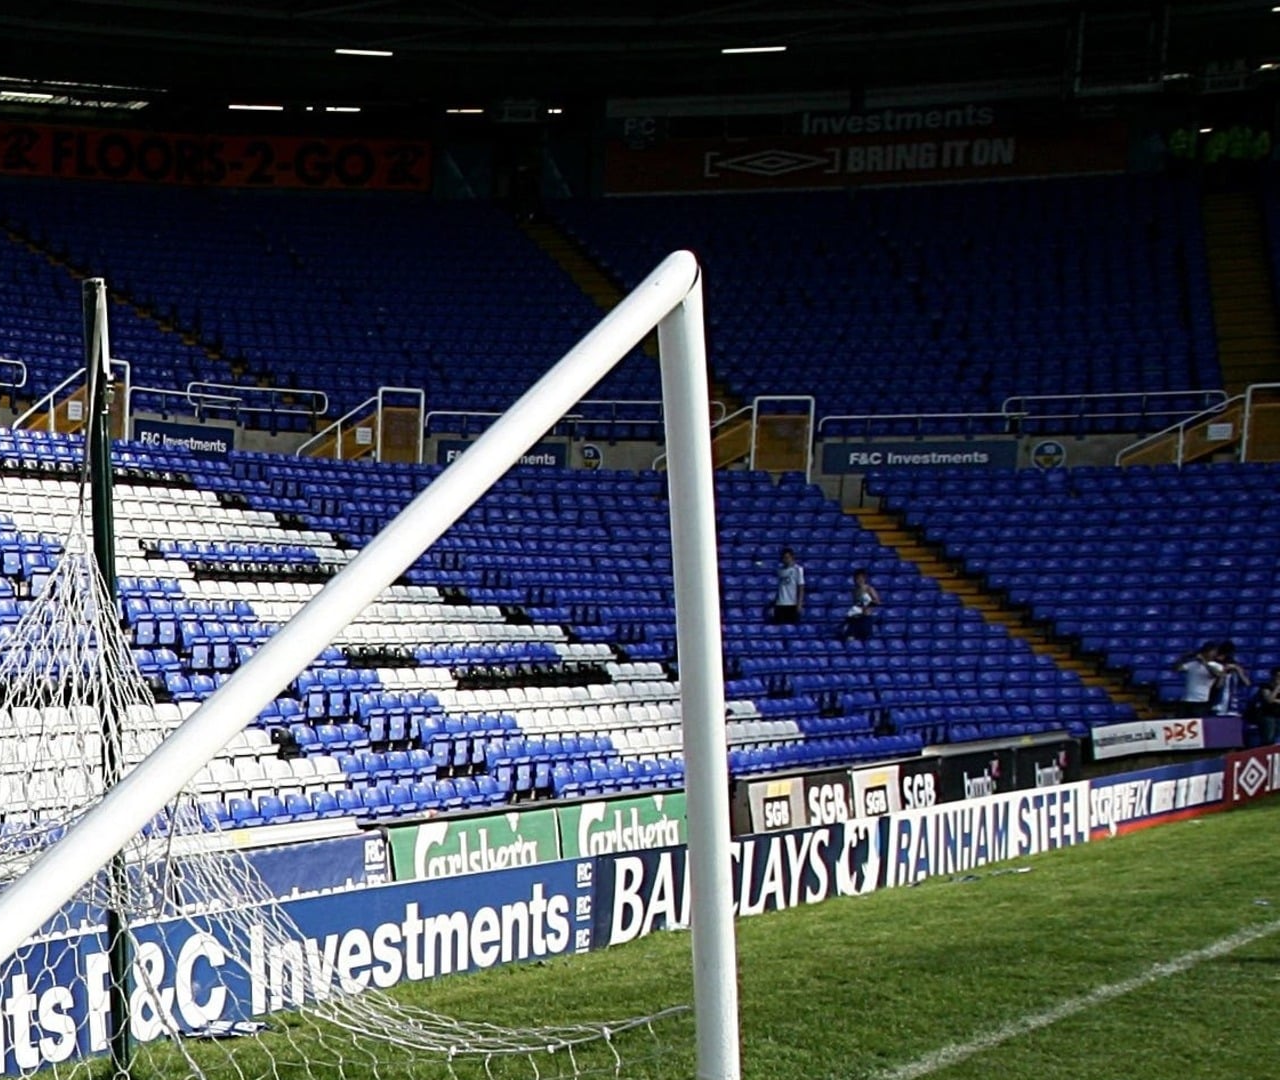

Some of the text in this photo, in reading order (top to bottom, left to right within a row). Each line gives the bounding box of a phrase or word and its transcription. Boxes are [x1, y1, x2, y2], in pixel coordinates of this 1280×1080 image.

[51, 130, 377, 187] FLOORS-2-GO
[846, 144, 938, 174] BRING
[971, 137, 1016, 167] ON
[140, 430, 160, 447] F&C
[849, 450, 990, 466] F&C Investments
[764, 783, 849, 828] SGB SGB
[864, 773, 936, 815] SGB SGB
[898, 800, 1011, 888] RAINHAM
[1017, 787, 1088, 857] STEEL
[249, 882, 571, 1017] Investments
